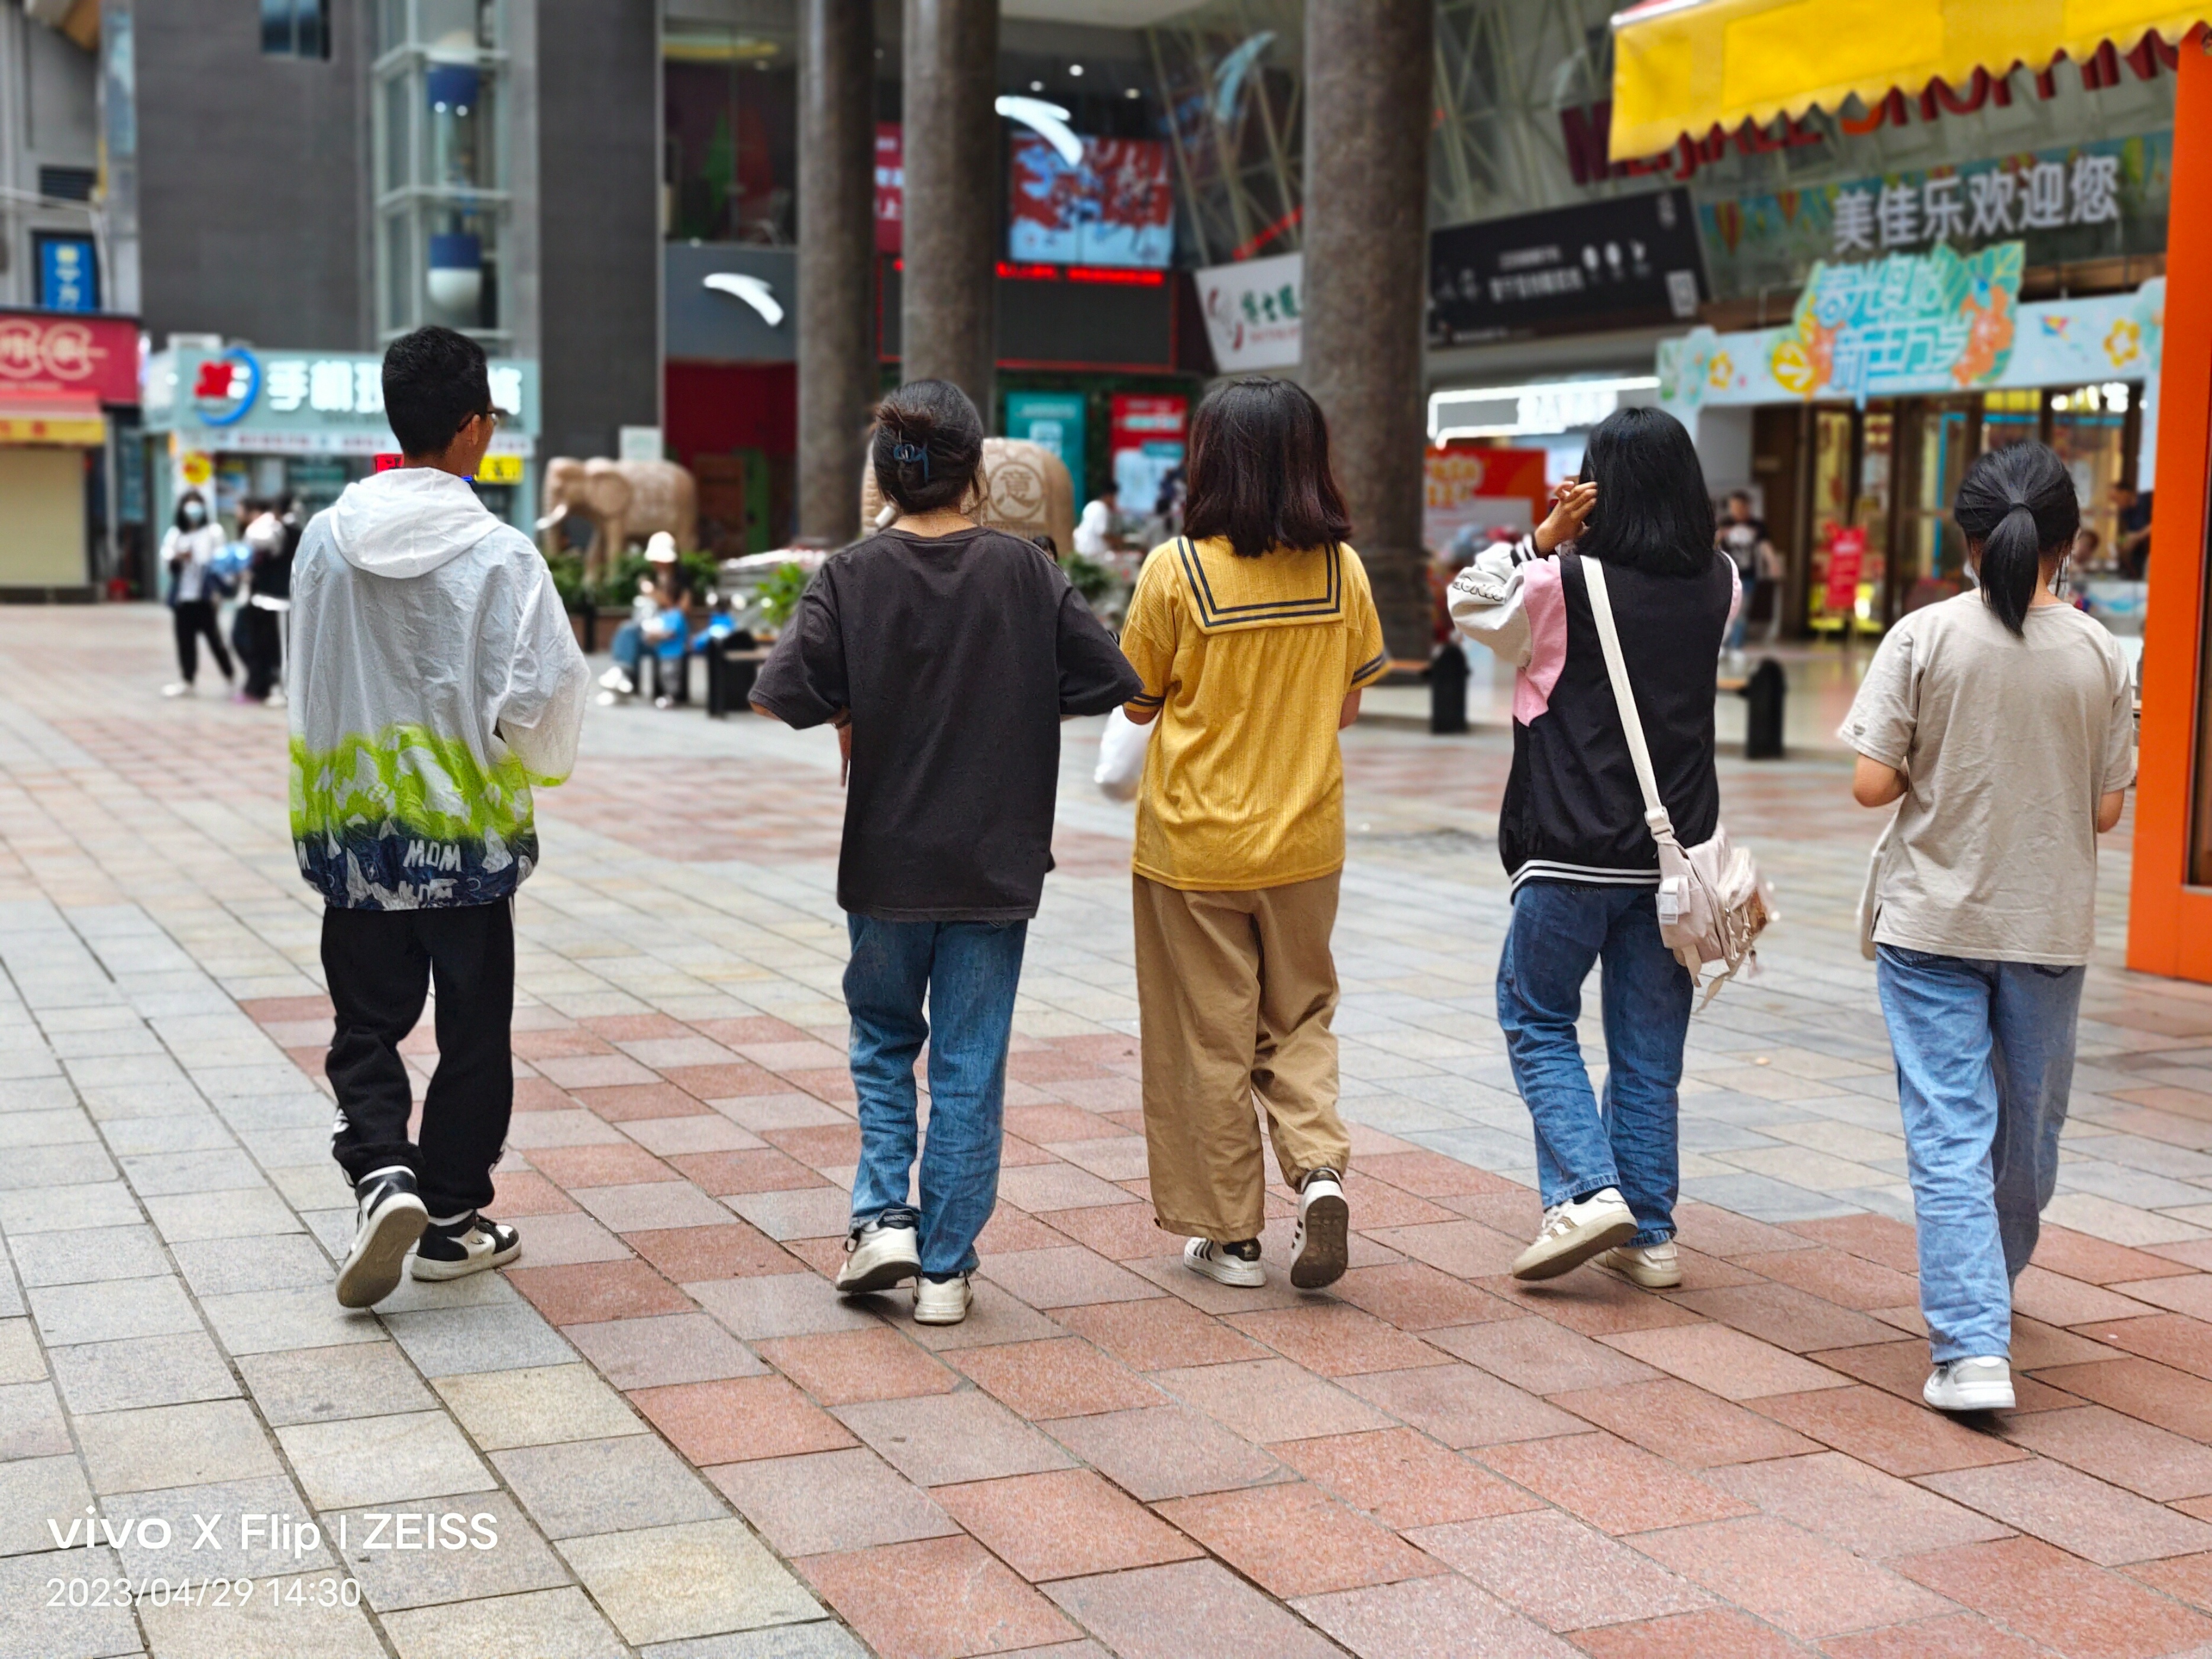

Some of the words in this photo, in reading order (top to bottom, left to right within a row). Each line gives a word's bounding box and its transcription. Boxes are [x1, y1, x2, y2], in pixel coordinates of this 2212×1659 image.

[1833, 155, 2120, 253] 美佳乐欢迎您
[402, 839, 461, 872] MOM
